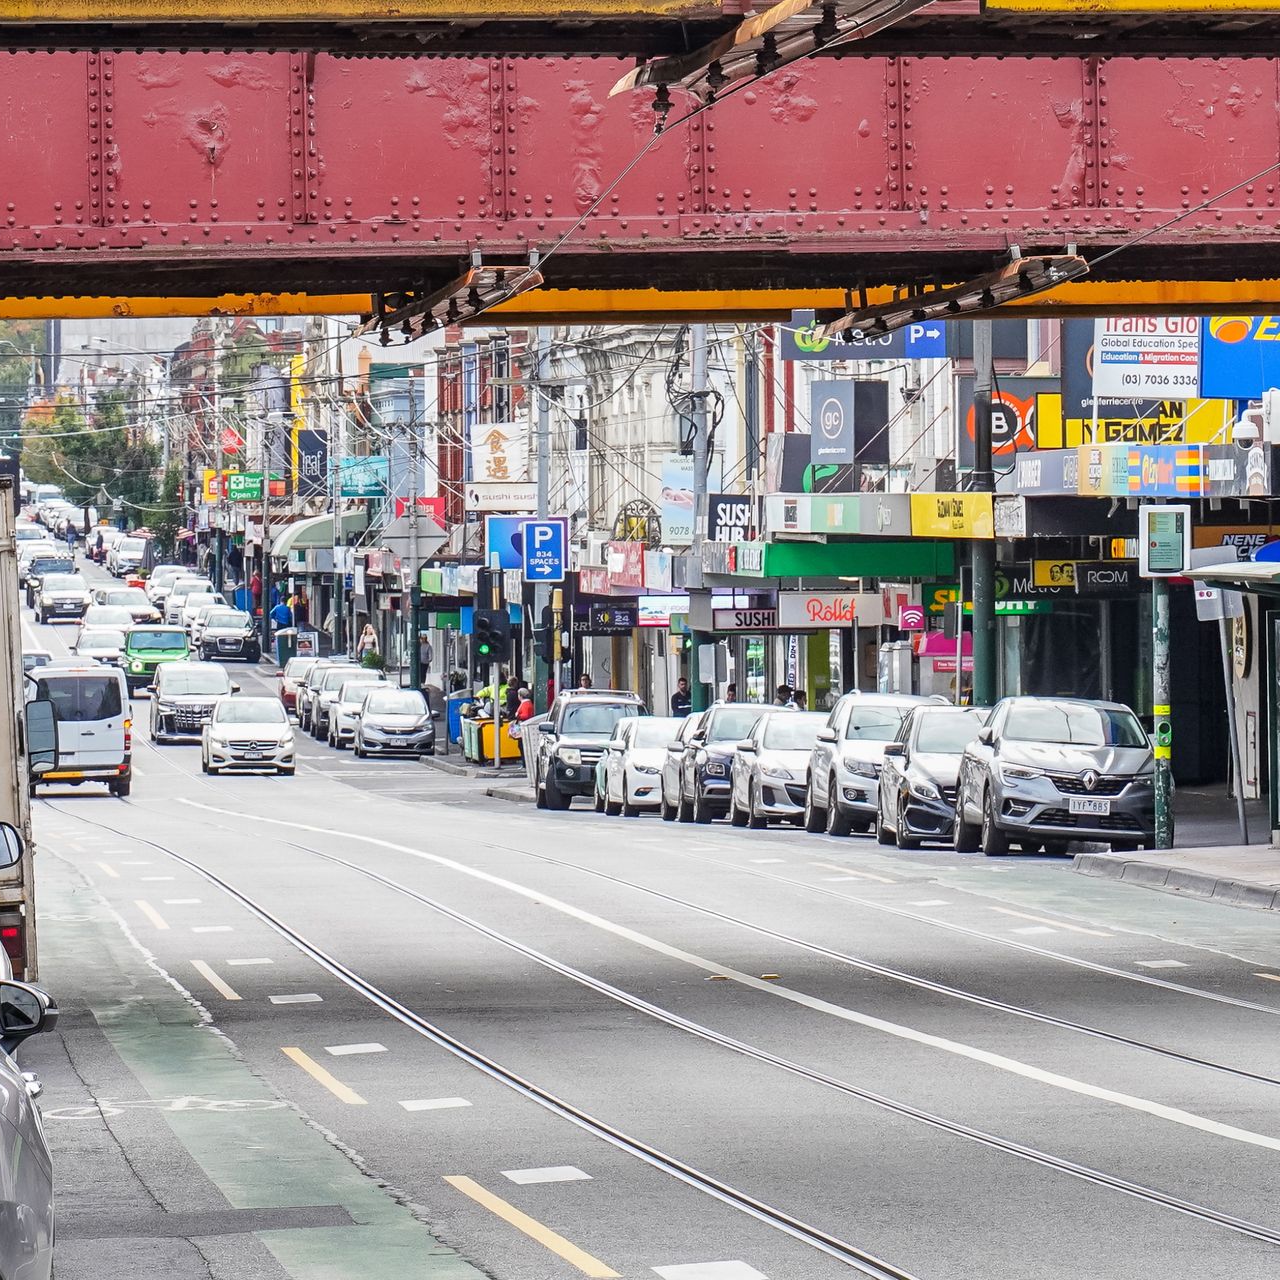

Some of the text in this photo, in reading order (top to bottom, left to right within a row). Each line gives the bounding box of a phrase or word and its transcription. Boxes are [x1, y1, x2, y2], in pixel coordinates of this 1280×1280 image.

[1103, 317, 1198, 333] Trans Glo
[910, 325, 924, 344] P
[1101, 338, 1131, 349] Global
[1132, 337, 1175, 349] Education
[1102, 352, 1198, 363] Education & Migration Cons
[1121, 375, 1198, 387] (03) 7036 3336
[824, 412, 840, 429] gc
[301, 450, 323, 476] leaf
[230, 491, 251, 499] Open
[481, 493, 538, 501] sushi sush
[534, 526, 554, 548] P
[669, 527, 690, 535] 9078
[1222, 534, 1267, 546] NENE
[735, 612, 776, 627] SUSHI
